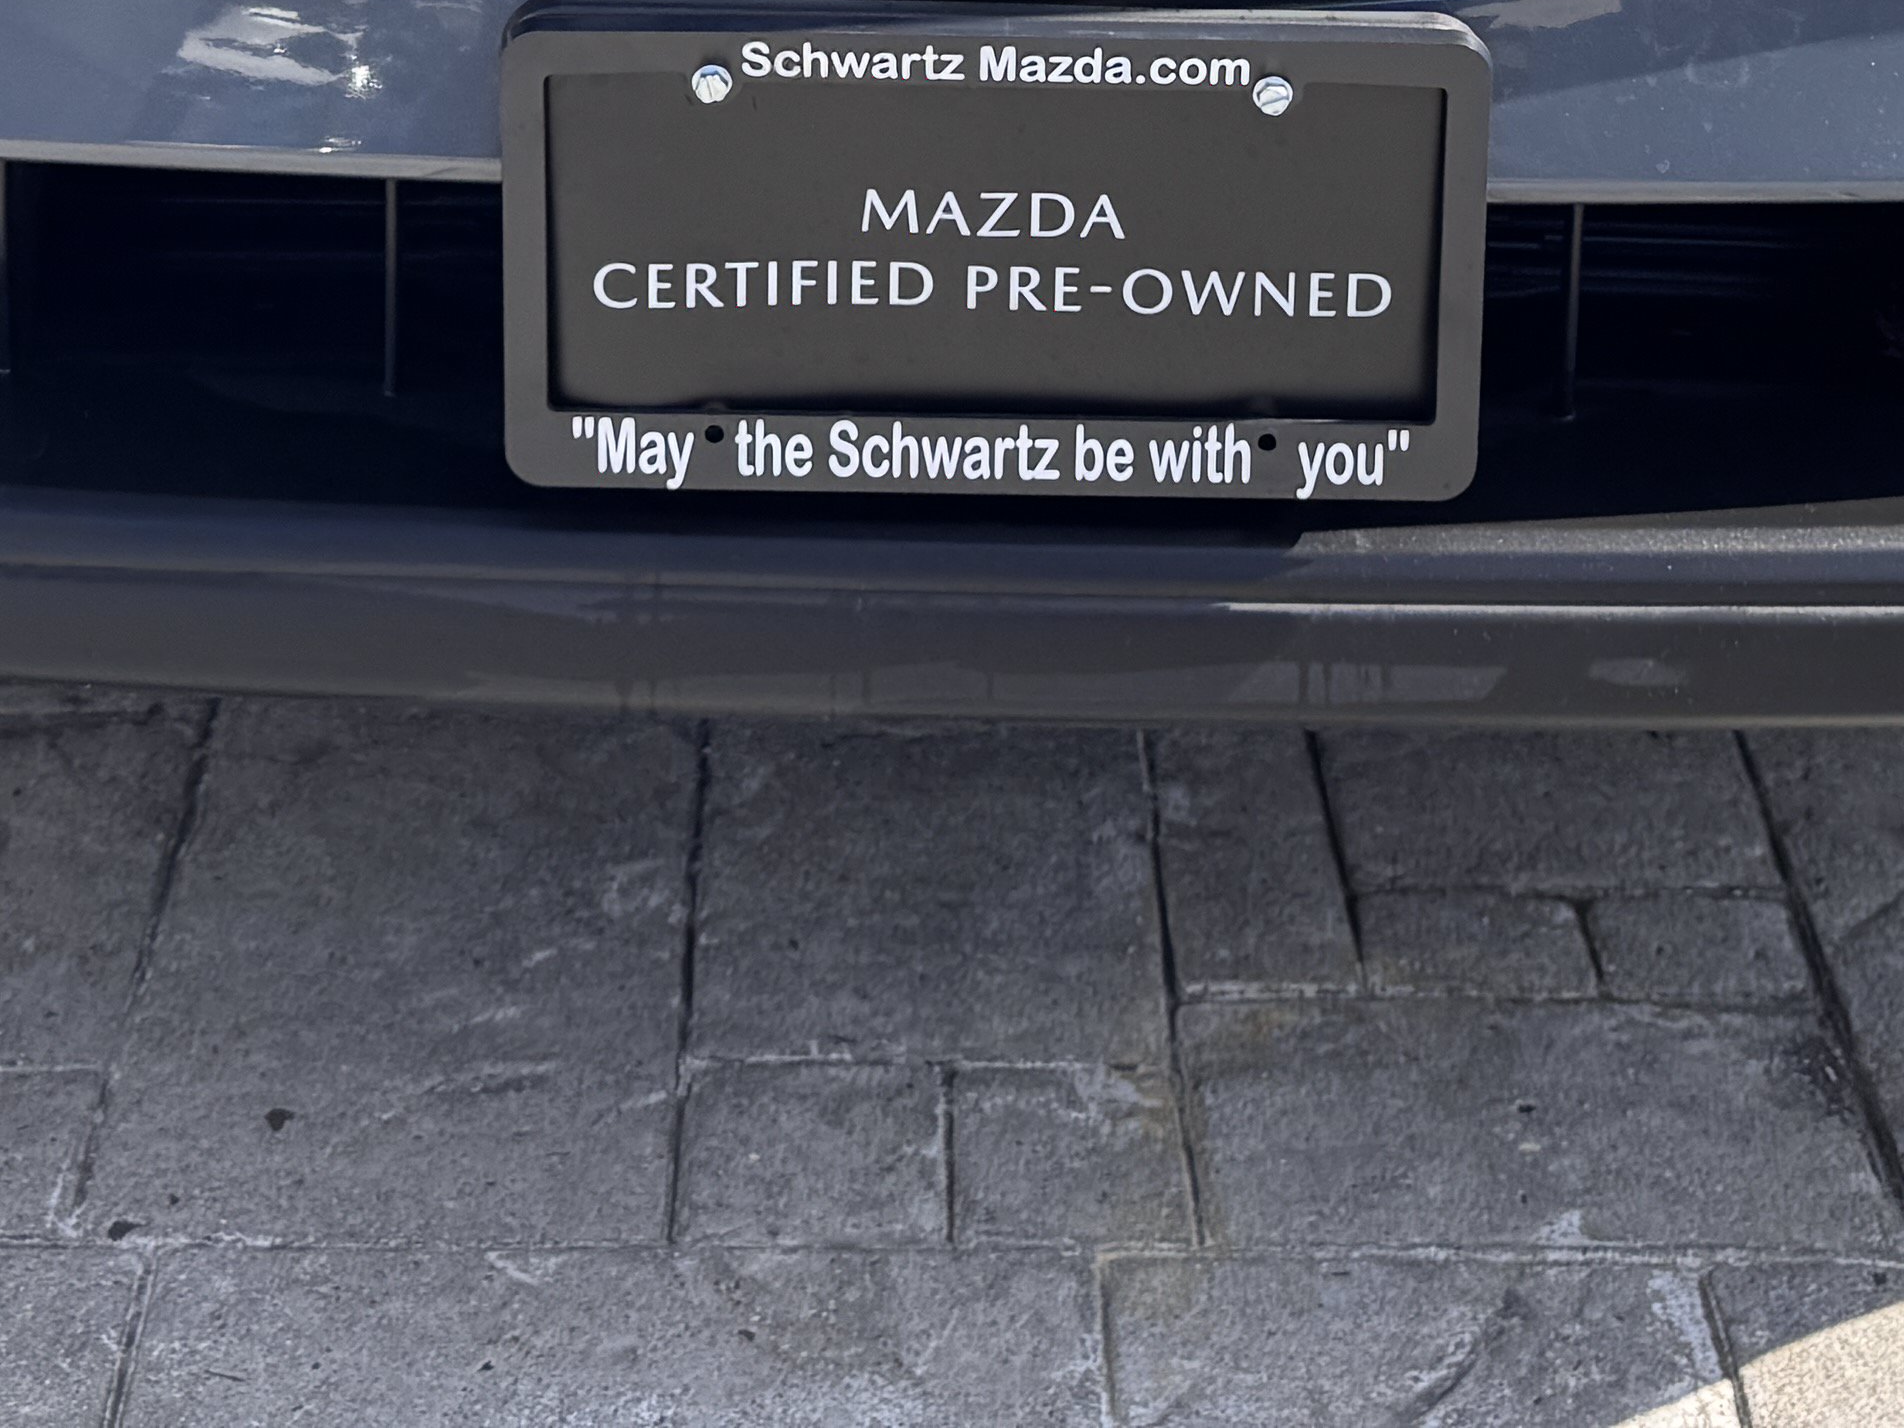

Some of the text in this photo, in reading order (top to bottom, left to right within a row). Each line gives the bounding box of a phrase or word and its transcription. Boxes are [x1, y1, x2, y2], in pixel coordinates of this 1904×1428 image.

[741, 41, 1252, 86] Schwartz Mazda.com
[861, 188, 1125, 240] MAZDA
[593, 260, 1393, 317] CERTIFIED PRE-OWNED
[572, 416, 1410, 500] "May the Schwartz be with you"
